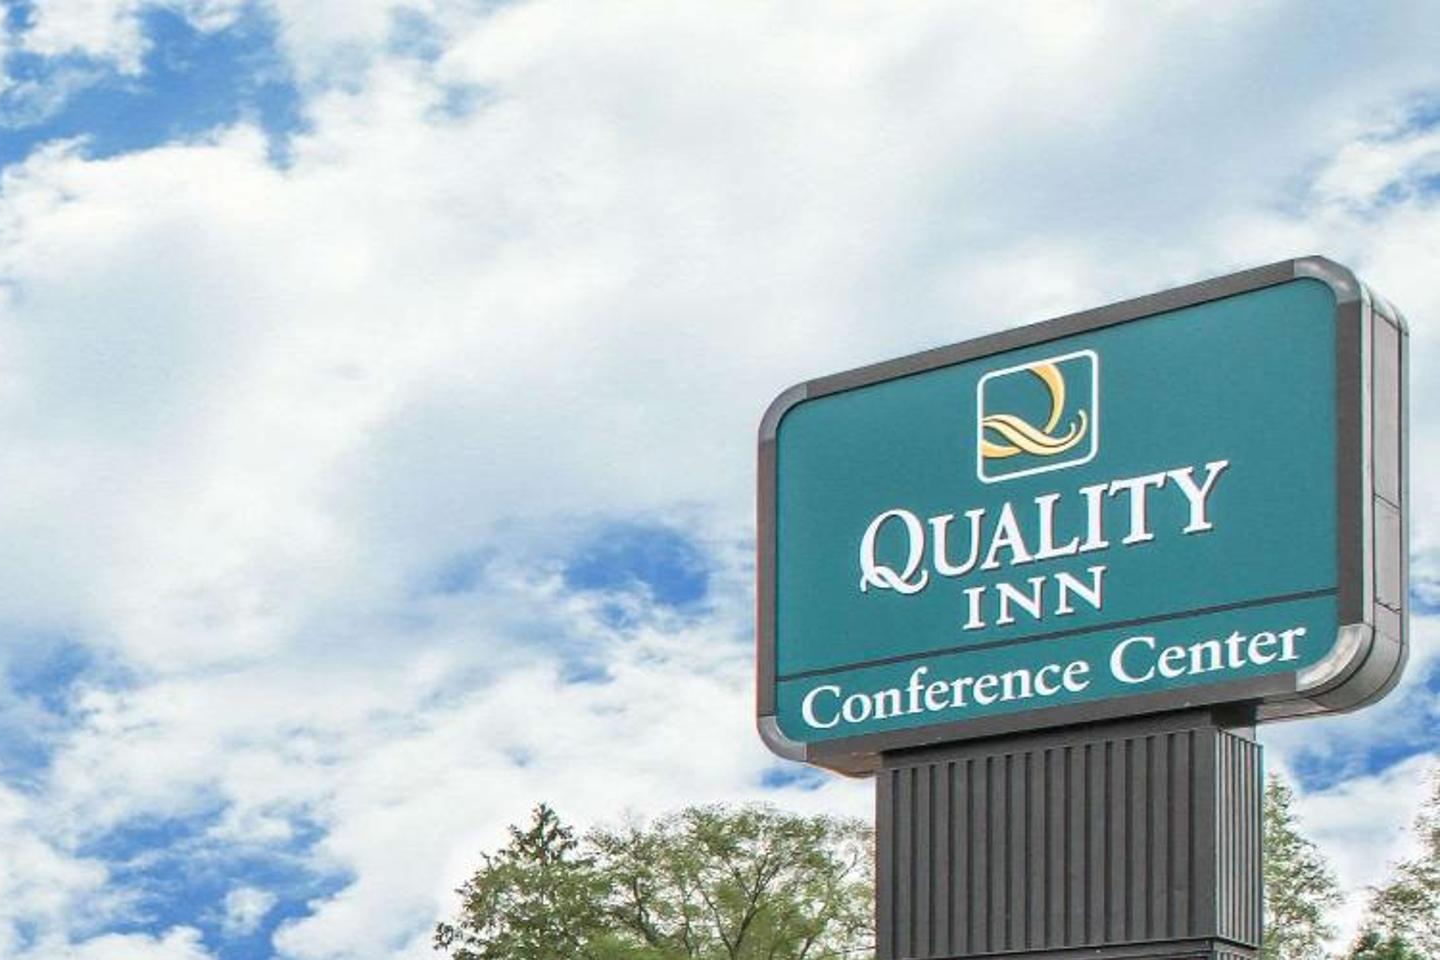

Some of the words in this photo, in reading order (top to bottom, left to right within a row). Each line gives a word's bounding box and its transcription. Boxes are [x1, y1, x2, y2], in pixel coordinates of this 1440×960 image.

[860, 460, 1228, 594] QUALITY
[963, 566, 1107, 631] INN
[801, 656, 1091, 729] Conference
[1110, 625, 1308, 684] Center
